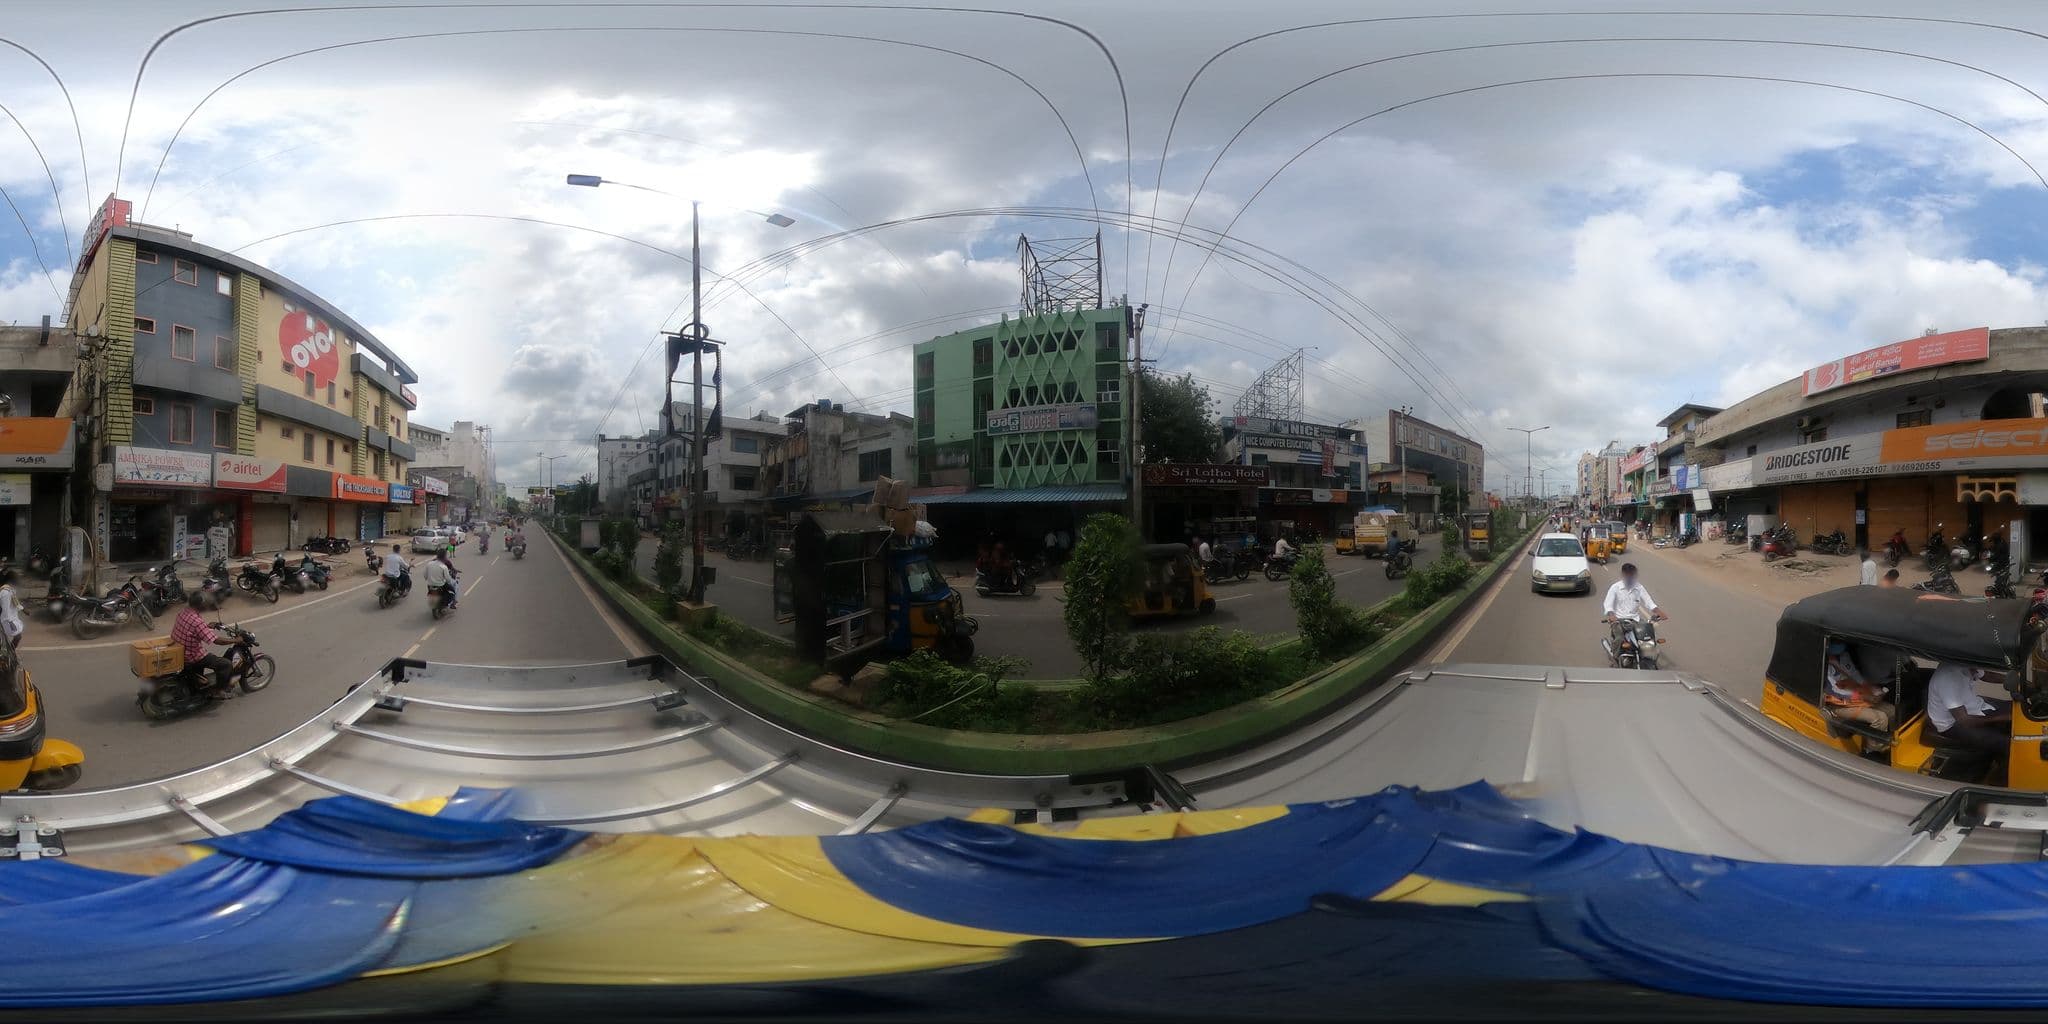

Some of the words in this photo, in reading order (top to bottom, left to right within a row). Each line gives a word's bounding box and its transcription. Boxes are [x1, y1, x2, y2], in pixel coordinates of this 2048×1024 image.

[291, 331, 331, 368] OYO
[1023, 414, 1053, 430] LODGE
[1290, 423, 1321, 436] NICE
[1259, 437, 1286, 447] COMPUTER
[118, 452, 153, 464] AMBIKA
[155, 455, 184, 466] POWER
[185, 456, 209, 468] TOOLS
[1765, 444, 1851, 471] BRIDGESTONE
[234, 461, 262, 476] airtel
[1171, 467, 1190, 477] Sri
[1195, 467, 1231, 477] Latha
[1236, 469, 1265, 478] Hotel
[1790, 472, 1808, 481] TYRES
